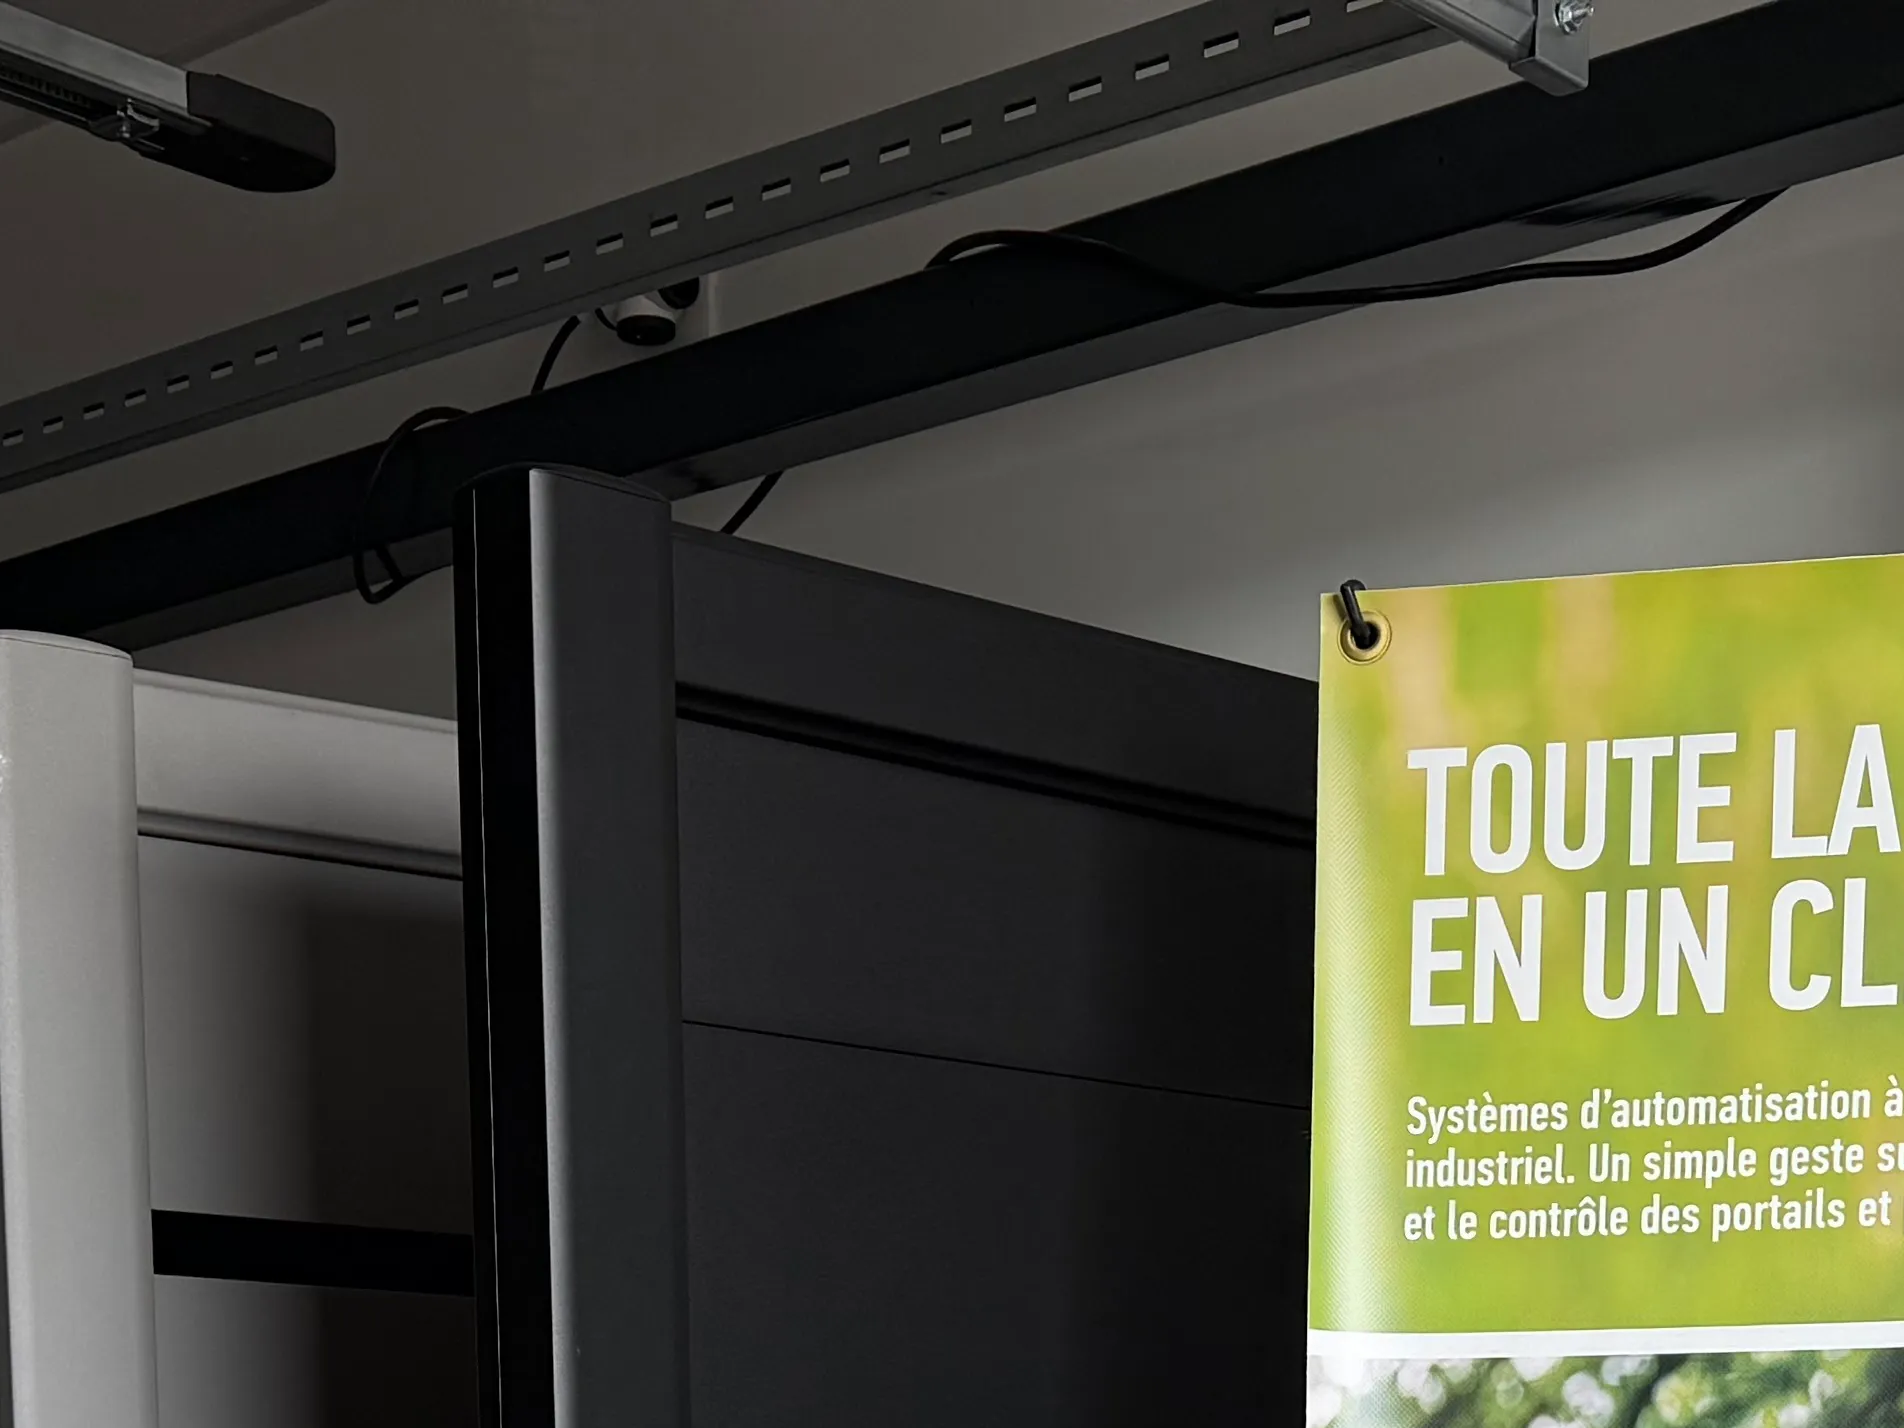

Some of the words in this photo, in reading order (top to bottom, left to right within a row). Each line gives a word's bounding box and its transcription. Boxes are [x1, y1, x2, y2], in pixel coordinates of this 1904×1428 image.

[1407, 732, 1737, 876] TOUTE
[1771, 723, 1902, 859] LA
[1409, 894, 1543, 1026] EN
[1583, 884, 1729, 1020] UN
[1407, 1091, 1568, 1145] Systèmes
[1884, 1075, 1904, 1117] à
[1406, 1143, 1575, 1188] industriel.
[1589, 1143, 1630, 1183] Un
[1643, 1136, 1757, 1189] simple
[1769, 1138, 1864, 1187] geste
[1404, 1206, 1436, 1241] et
[1448, 1199, 1478, 1240] le
[1489, 1195, 1629, 1239] contrôle
[1641, 1193, 1700, 1235] des
[1712, 1187, 1845, 1242] portails
[1858, 1190, 1893, 1227] et
